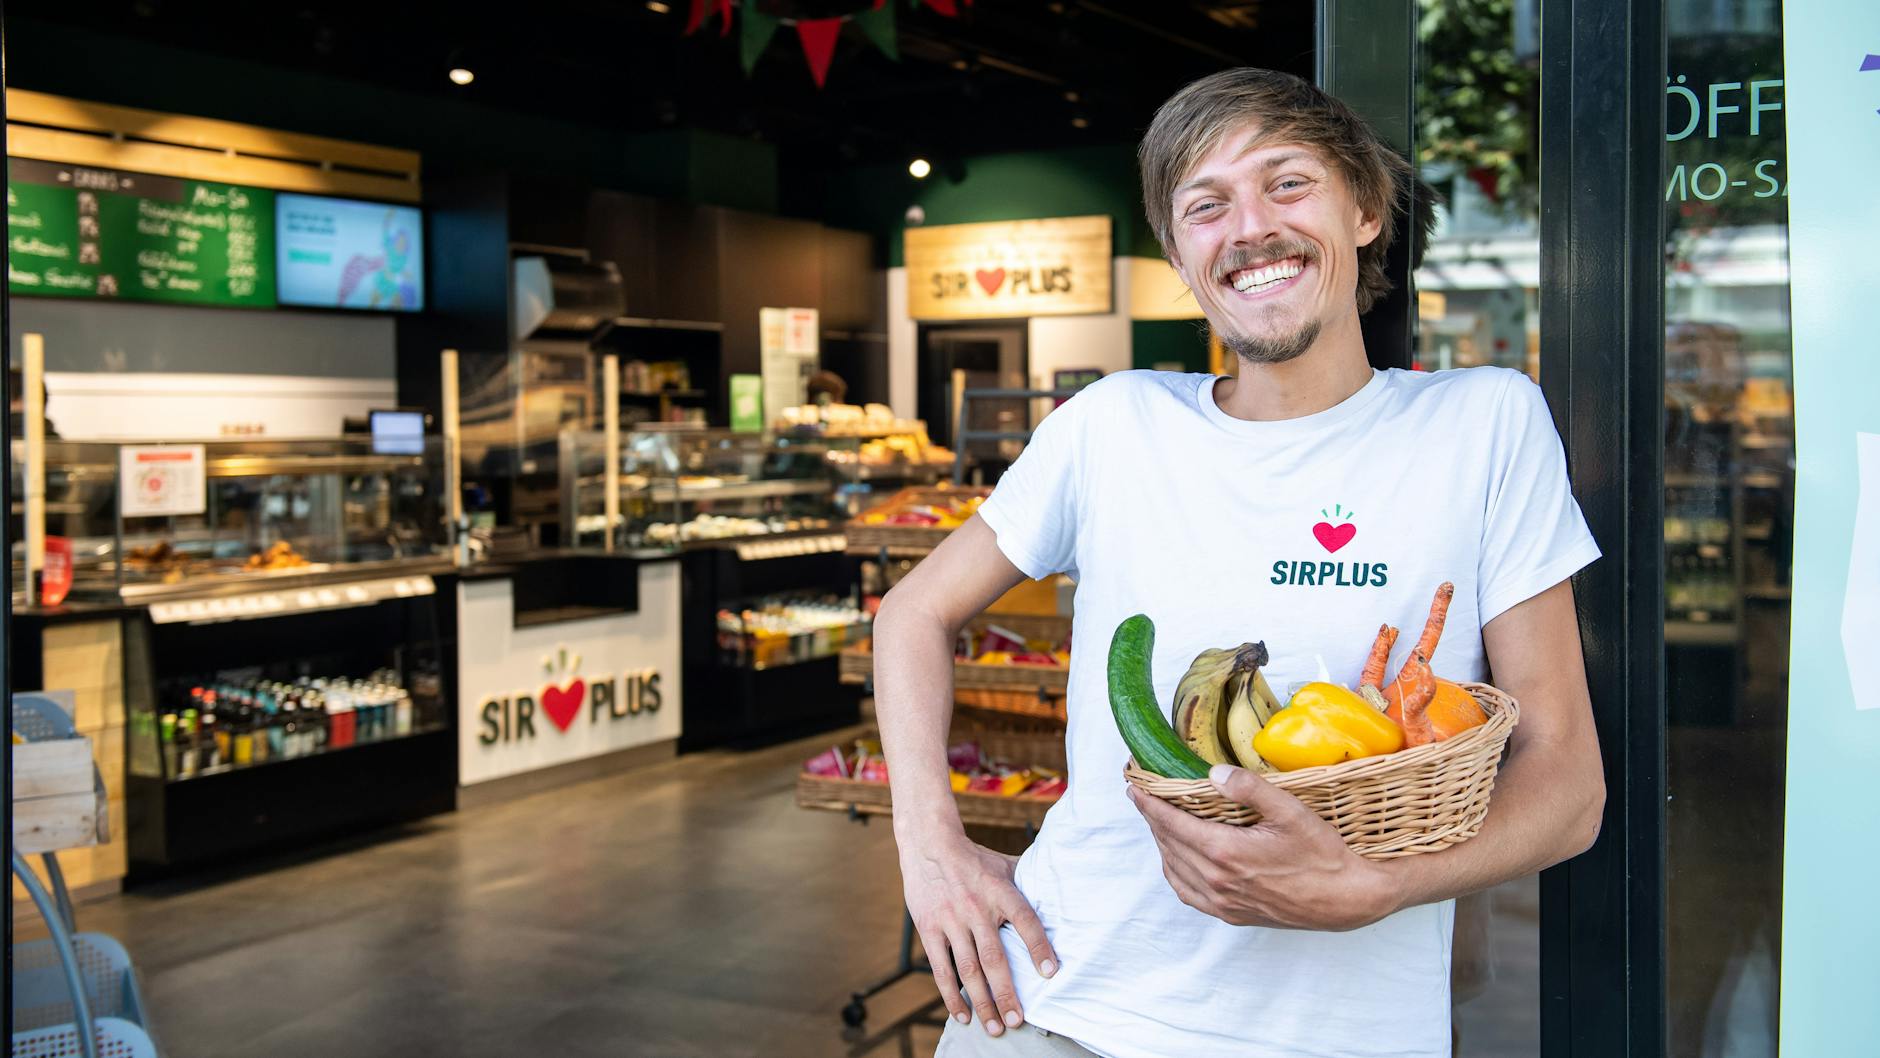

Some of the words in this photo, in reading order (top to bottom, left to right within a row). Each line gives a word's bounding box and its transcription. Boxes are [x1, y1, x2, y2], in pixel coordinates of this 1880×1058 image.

[1666, 159, 1789, 202] MO-S
[1011, 266, 1073, 295] PLUS
[1270, 560, 1388, 588] SIRPLUS
[479, 695, 536, 746] SIR
[590, 671, 662, 724] PLUS
